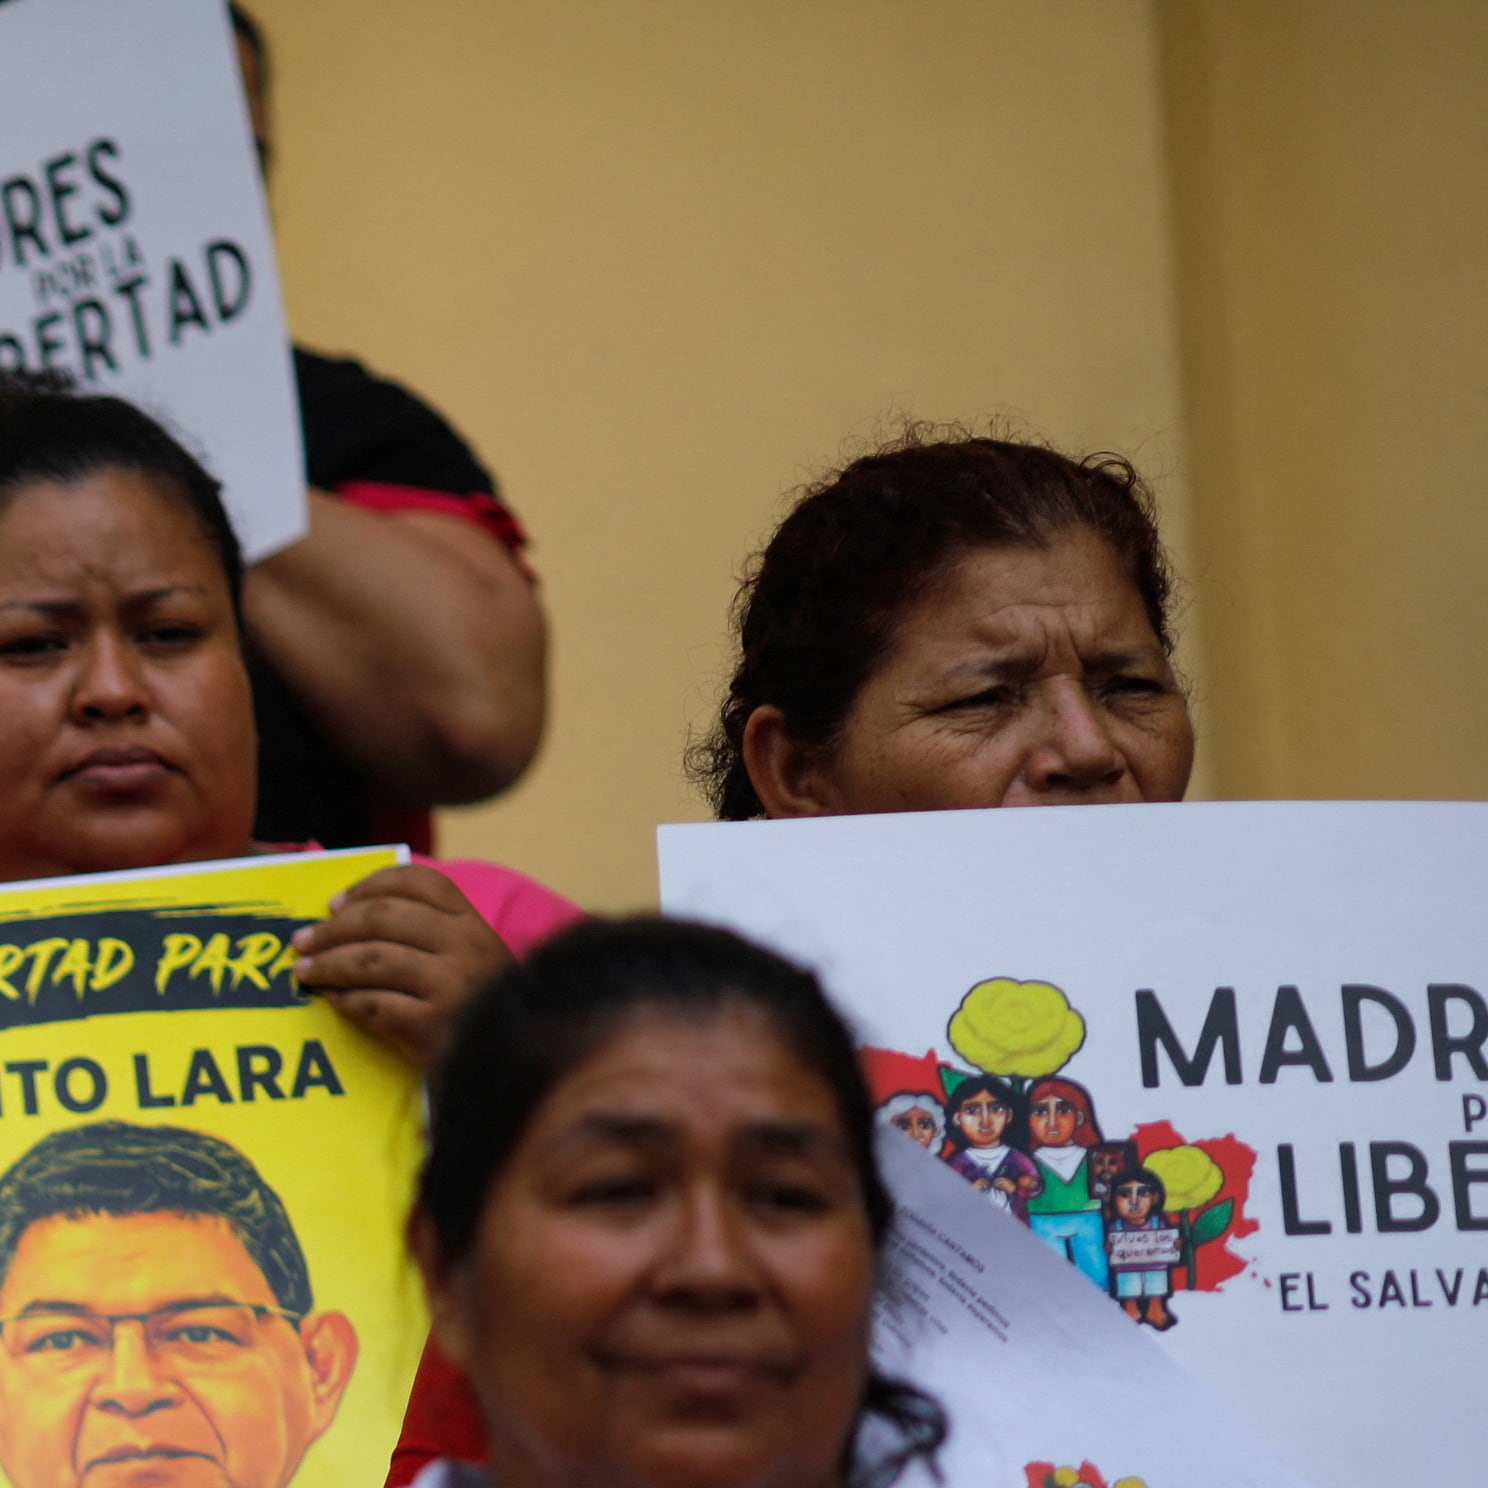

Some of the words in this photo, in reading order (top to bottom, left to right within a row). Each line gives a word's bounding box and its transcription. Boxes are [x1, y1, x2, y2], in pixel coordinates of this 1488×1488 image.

[100, 236, 145, 276] LA
[1135, 984, 1488, 1088] MADR
[133, 1039, 346, 1110] LARA
[1280, 1273, 1328, 1311] EL
